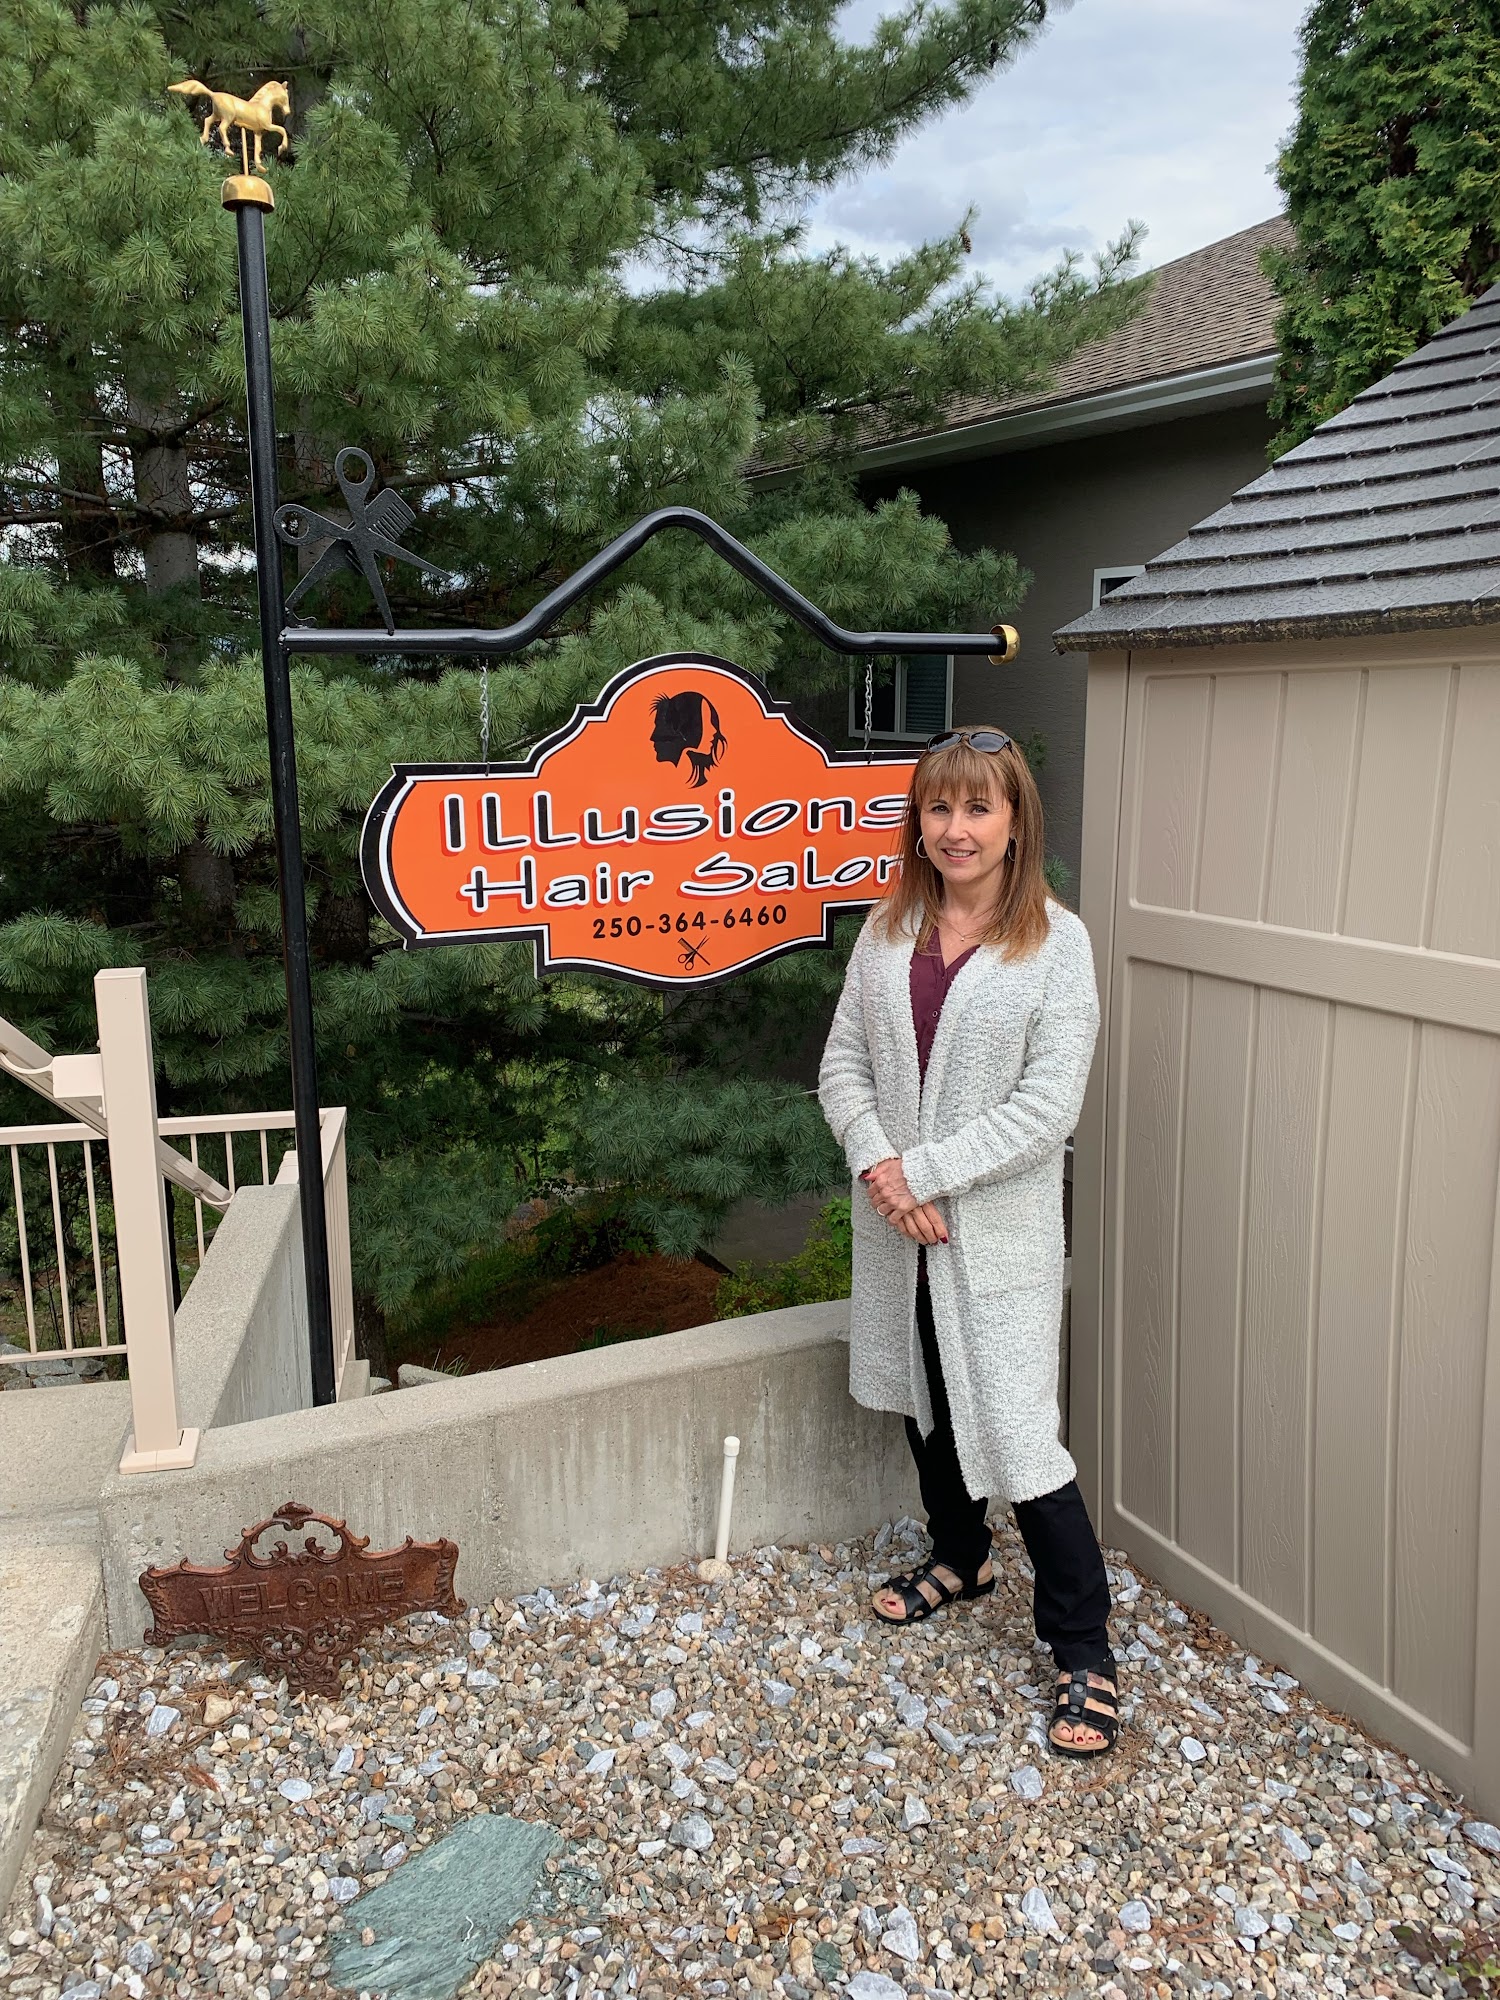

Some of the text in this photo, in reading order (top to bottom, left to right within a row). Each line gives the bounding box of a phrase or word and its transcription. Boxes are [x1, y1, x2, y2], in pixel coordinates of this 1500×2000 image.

[459, 855, 654, 912] Hair
[592, 905, 787, 939] 250-364-6460
[199, 1568, 404, 1620] WELCOME
